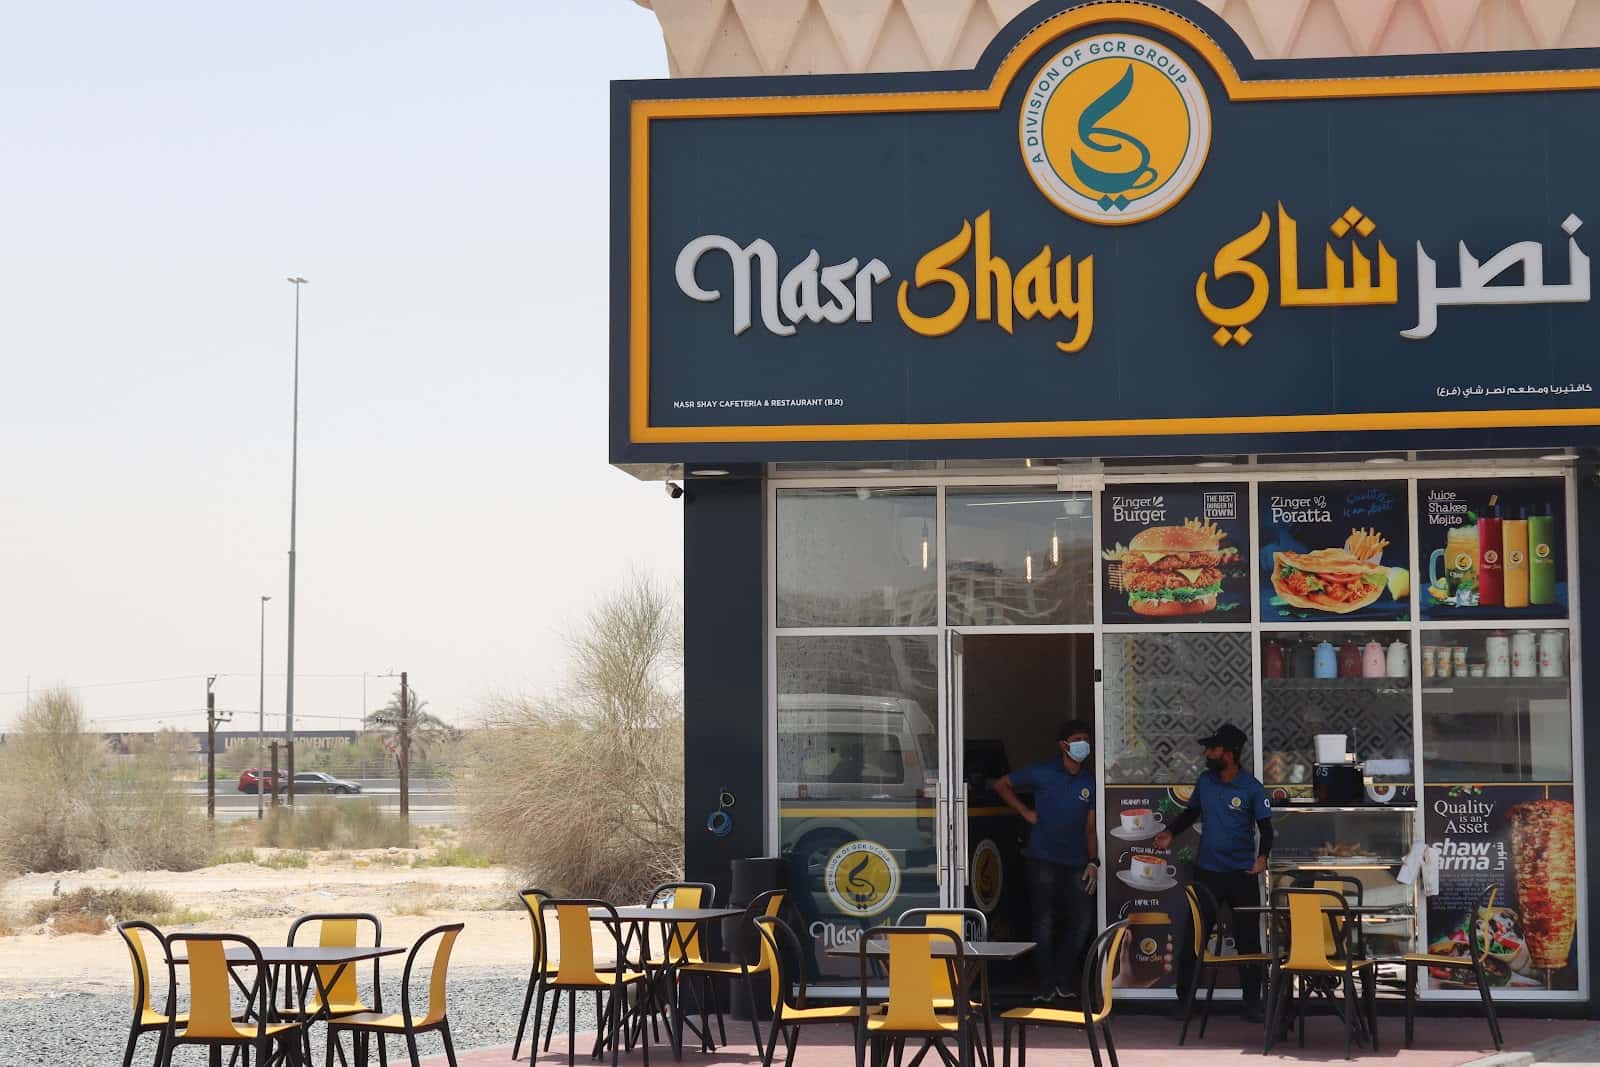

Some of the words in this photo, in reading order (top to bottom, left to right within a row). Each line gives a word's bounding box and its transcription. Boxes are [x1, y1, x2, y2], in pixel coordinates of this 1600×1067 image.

[1089, 41, 1126, 55] GCR
[1062, 49, 1082, 67] OF
[1133, 44, 1187, 85] GROUP
[1026, 68, 1060, 147] DIVISION
[1032, 153, 1044, 163] A
[1195, 200, 1399, 348] شاي
[1399, 213, 1591, 340] نصر
[675, 234, 892, 337] Nasr
[896, 209, 1095, 354] Shay
[1436, 386, 1461, 397] (فرع)
[1462, 385, 1484, 398] شاي
[1485, 386, 1506, 396] نصر
[1507, 385, 1549, 395] ومطعم
[1550, 383, 1593, 395] كافتيريا
[719, 400, 762, 408] CAFETERIA
[771, 399, 823, 407] RESTAURANT
[824, 398, 844, 408] (B.R)
[1428, 490, 1456, 500] Juice
[1112, 496, 1152, 509] Zinger
[1271, 496, 1312, 509] Zinger
[1428, 502, 1468, 513] Shakes
[1113, 507, 1166, 525] Burger
[1207, 509, 1234, 517] TOWN
[1271, 508, 1332, 523] Poratta
[1428, 515, 1462, 527] Mojito
[1434, 800, 1494, 817] Quality
[1459, 815, 1468, 823] is
[1443, 820, 1489, 834] Asset
[1432, 838, 1492, 856] shaw
